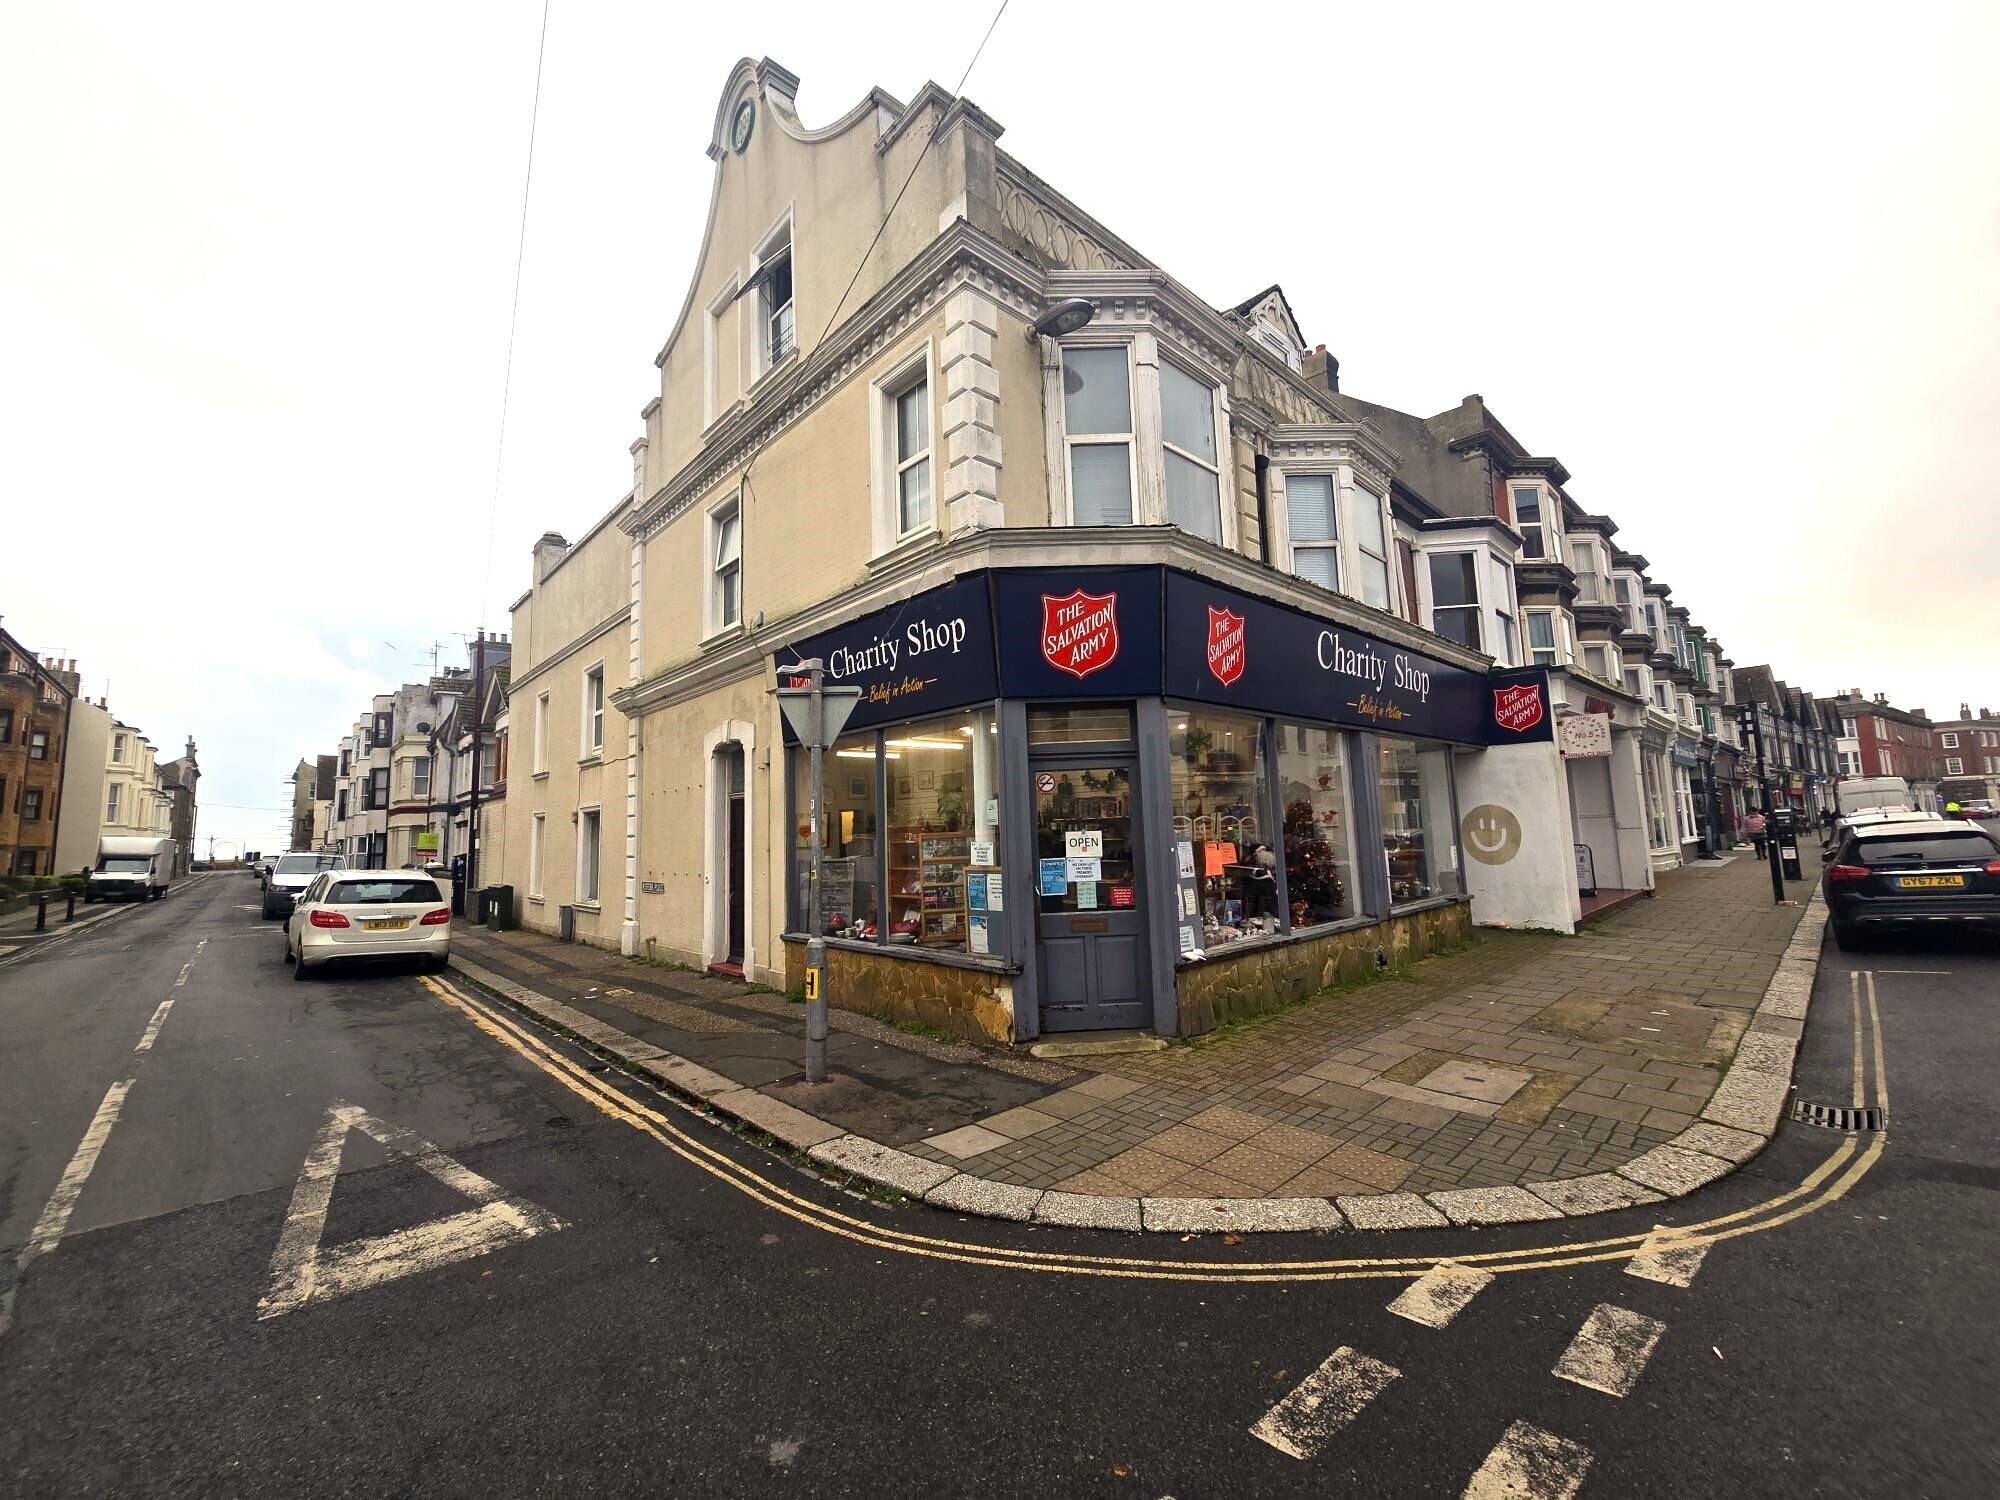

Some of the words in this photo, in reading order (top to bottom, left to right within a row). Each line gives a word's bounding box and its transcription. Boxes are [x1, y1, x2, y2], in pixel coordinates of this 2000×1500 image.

[1057, 601, 1085, 626] THE
[1216, 618, 1230, 638] THE
[1047, 604, 1111, 655] SALVATION
[1209, 625, 1243, 663] SALVATION
[830, 636, 900, 679] Charity
[907, 618, 966, 657] Shop
[1070, 628, 1109, 666] ARMY
[1221, 646, 1241, 676] ARMY
[1317, 631, 1387, 692] Charity
[1394, 654, 1430, 703] Shop
[869, 682, 891, 704] Belief
[892, 683, 899, 696] in
[900, 676, 924, 696] Action
[1503, 690, 1520, 705] THE
[1498, 690, 1537, 722] SALVATION
[1513, 703, 1536, 726] ARMY
[1070, 837, 1099, 847] OPEN
[1903, 877, 1933, 886] GY67
[1936, 877, 1961, 885] ZKL
